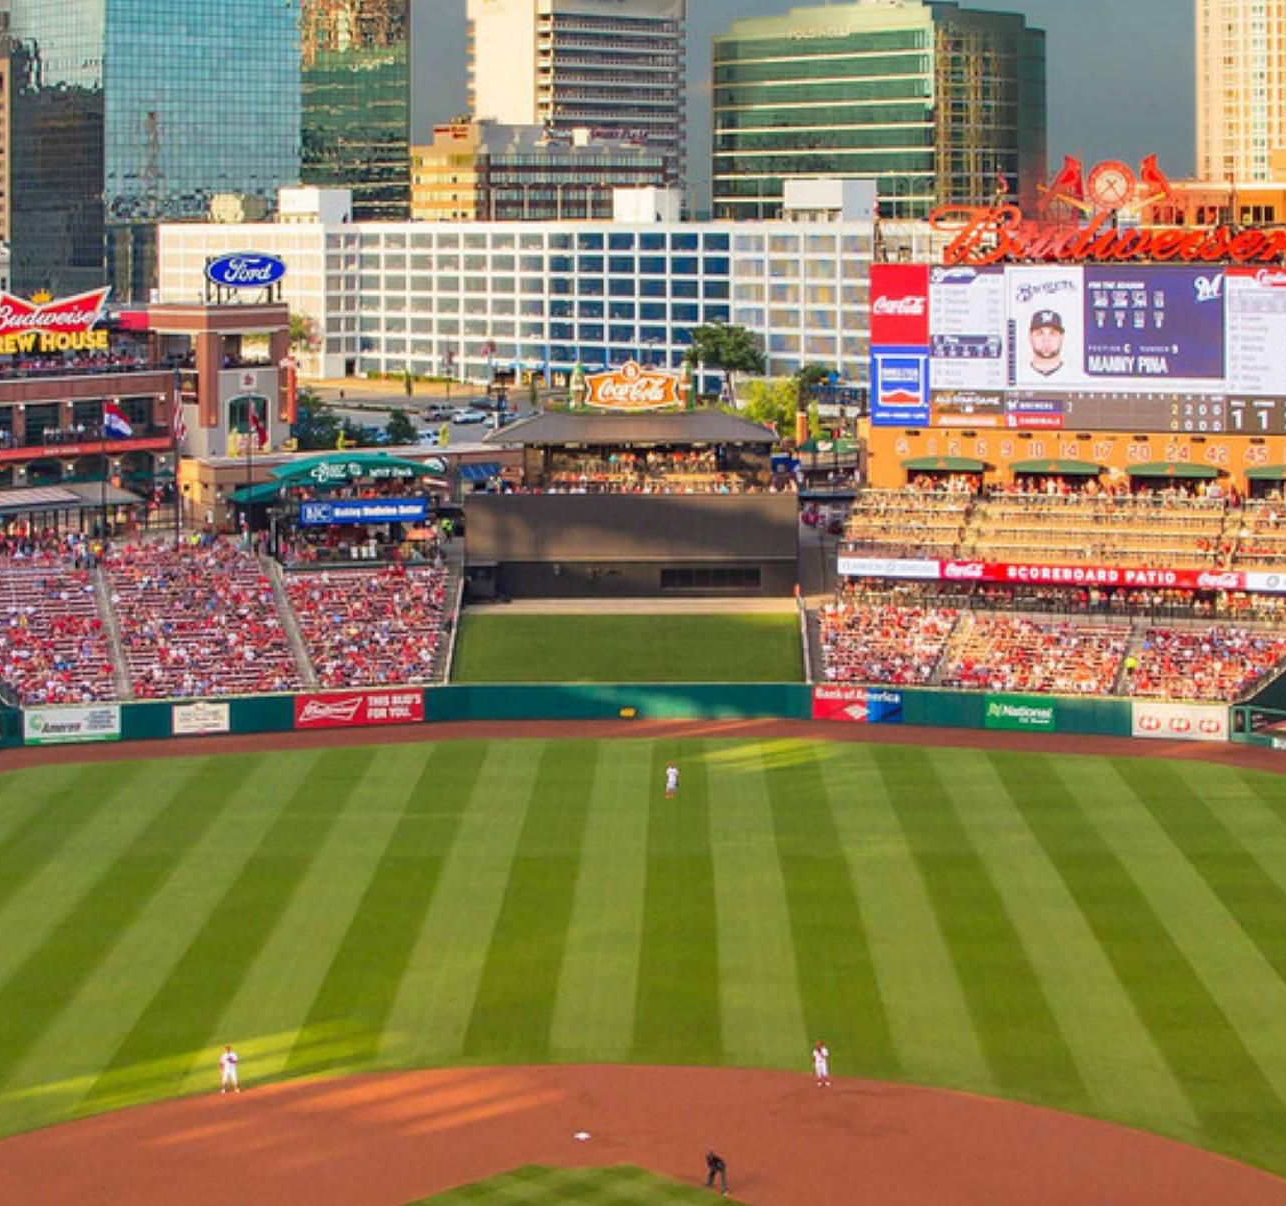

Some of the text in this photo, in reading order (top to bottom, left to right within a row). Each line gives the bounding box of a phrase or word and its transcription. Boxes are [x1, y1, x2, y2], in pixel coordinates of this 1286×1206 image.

[224, 258, 271, 281] Ford
[873, 294, 925, 315] Coca-Cola
[41, 330, 108, 350] HOUSE
[597, 377, 668, 401] Coca-Cola
[1231, 409, 1243, 429] 1
[1257, 410, 1268, 429] 1
[1128, 444, 1150, 460] 20
[1167, 445, 1190, 461] 24
[1205, 446, 1230, 462] 42
[1244, 447, 1269, 463] 45
[1007, 565, 1119, 583] SCOREBOARD
[1125, 571, 1177, 584] PATIO
[815, 686, 900, 704] Bank of America
[1002, 703, 1053, 719] National
[41, 721, 82, 734] Ameren
